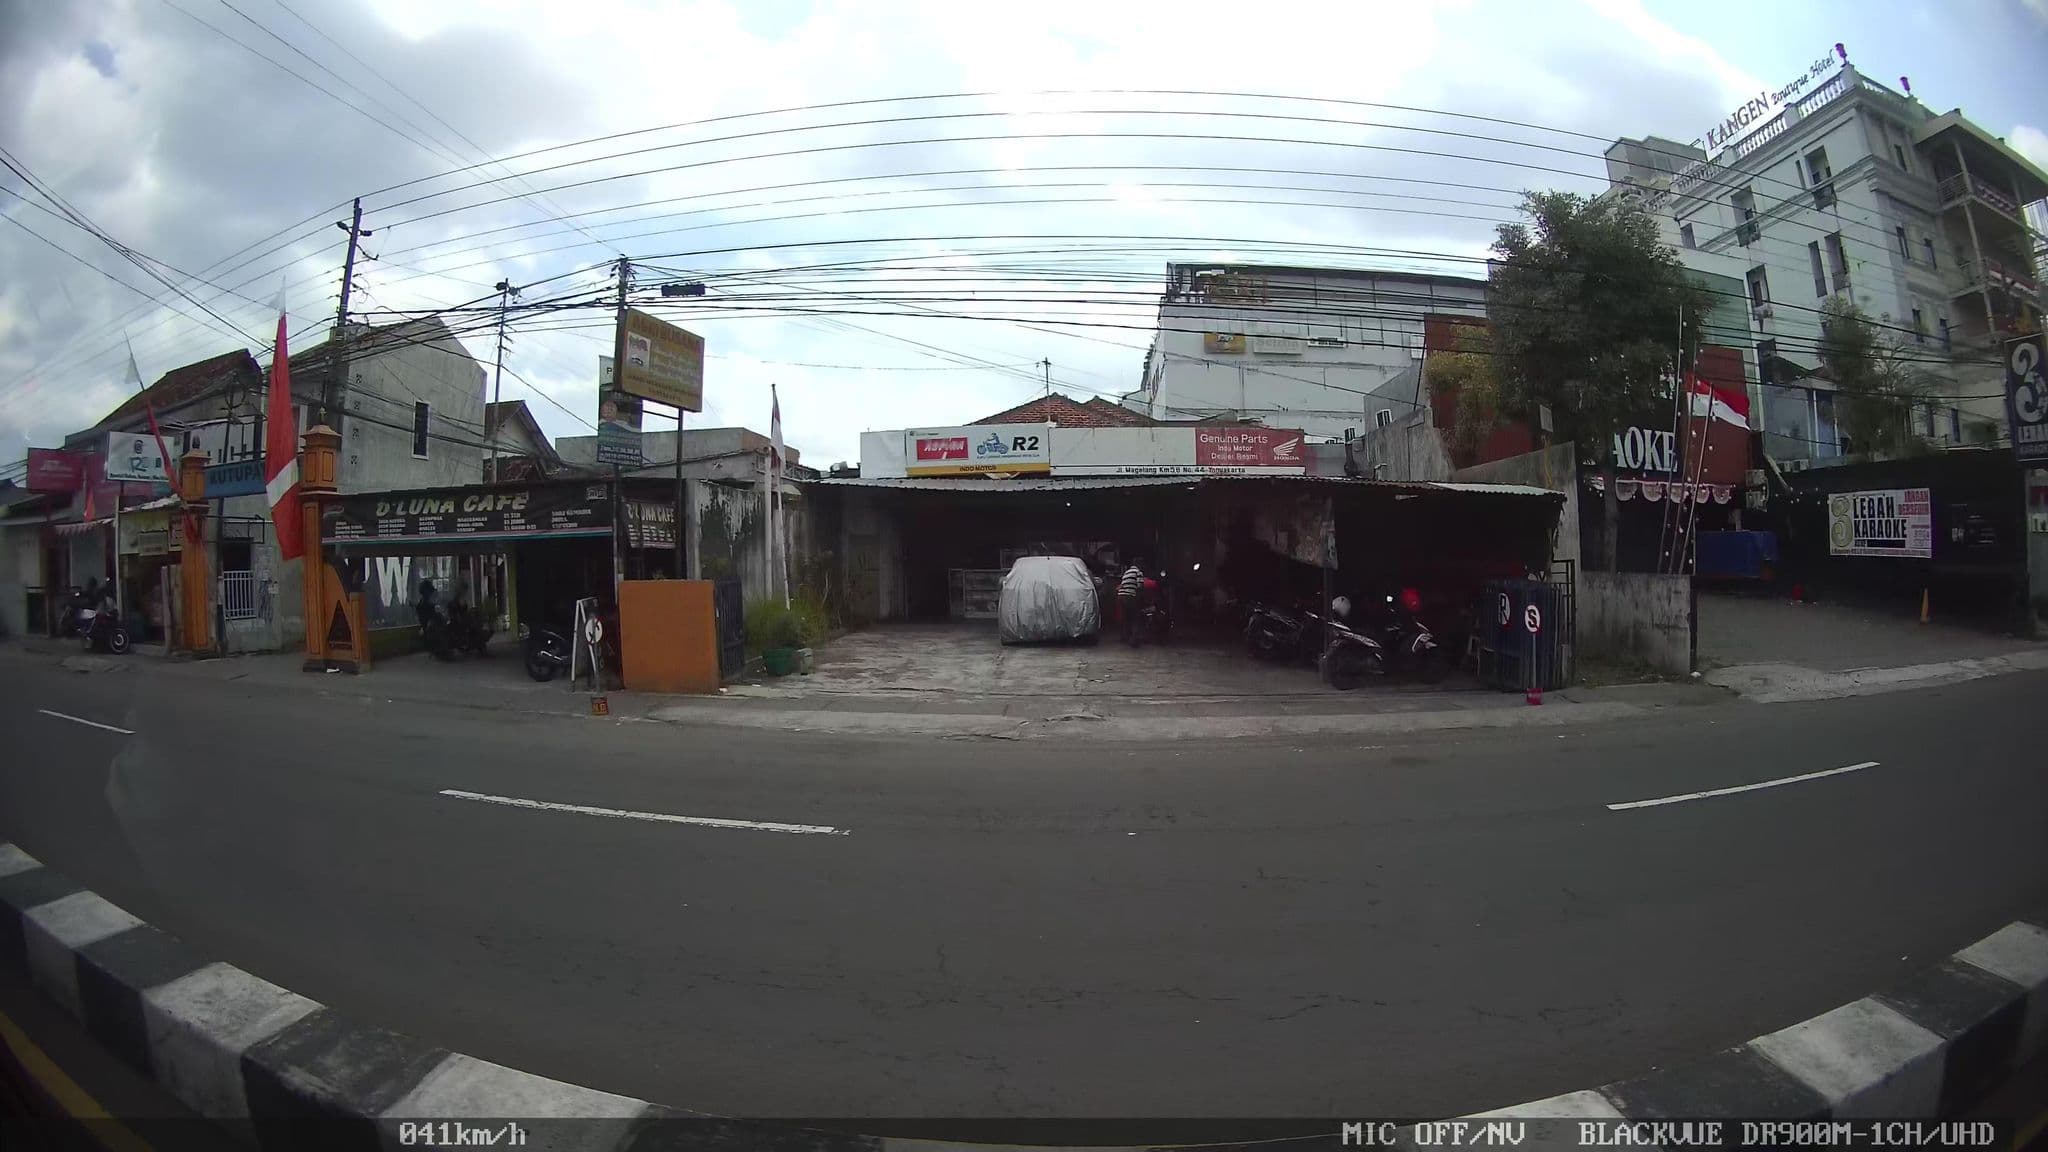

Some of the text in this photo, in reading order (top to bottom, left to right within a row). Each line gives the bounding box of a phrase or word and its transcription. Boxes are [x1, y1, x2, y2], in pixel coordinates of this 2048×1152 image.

[1706, 49, 1835, 150] KANGEN Boutique Hotel
[1012, 436, 1040, 451] R2
[1200, 433, 1268, 444] Genuine Parts
[463, 491, 529, 513] CAFE
[1853, 496, 1895, 519] LEBAH
[1854, 519, 1907, 538] KARAOKE
